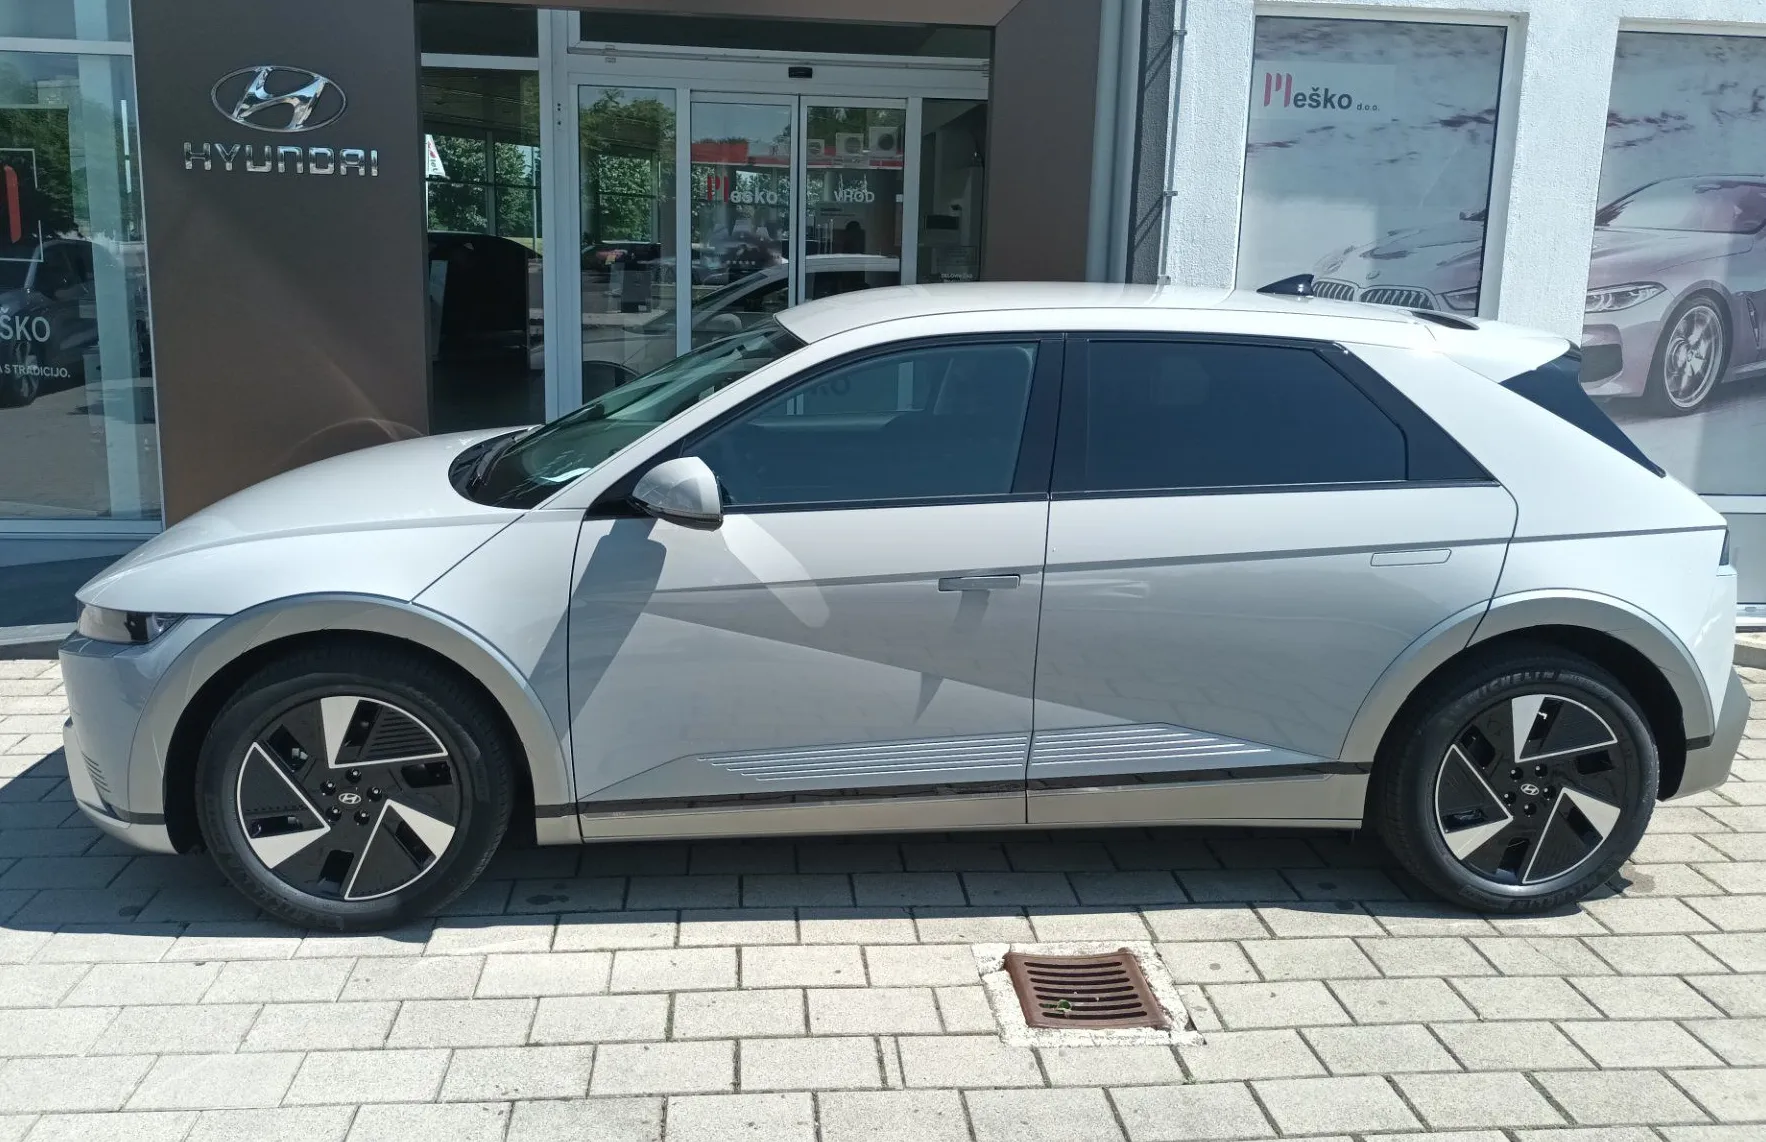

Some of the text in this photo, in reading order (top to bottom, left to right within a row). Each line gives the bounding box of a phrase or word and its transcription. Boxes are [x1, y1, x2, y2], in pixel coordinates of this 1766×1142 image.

[1263, 72, 1380, 111] Meško d.o.o.
[183, 141, 378, 177] HYUNDAI
[834, 189, 875, 203] VHOD
[12, 364, 71, 378] TRADICIJO.
